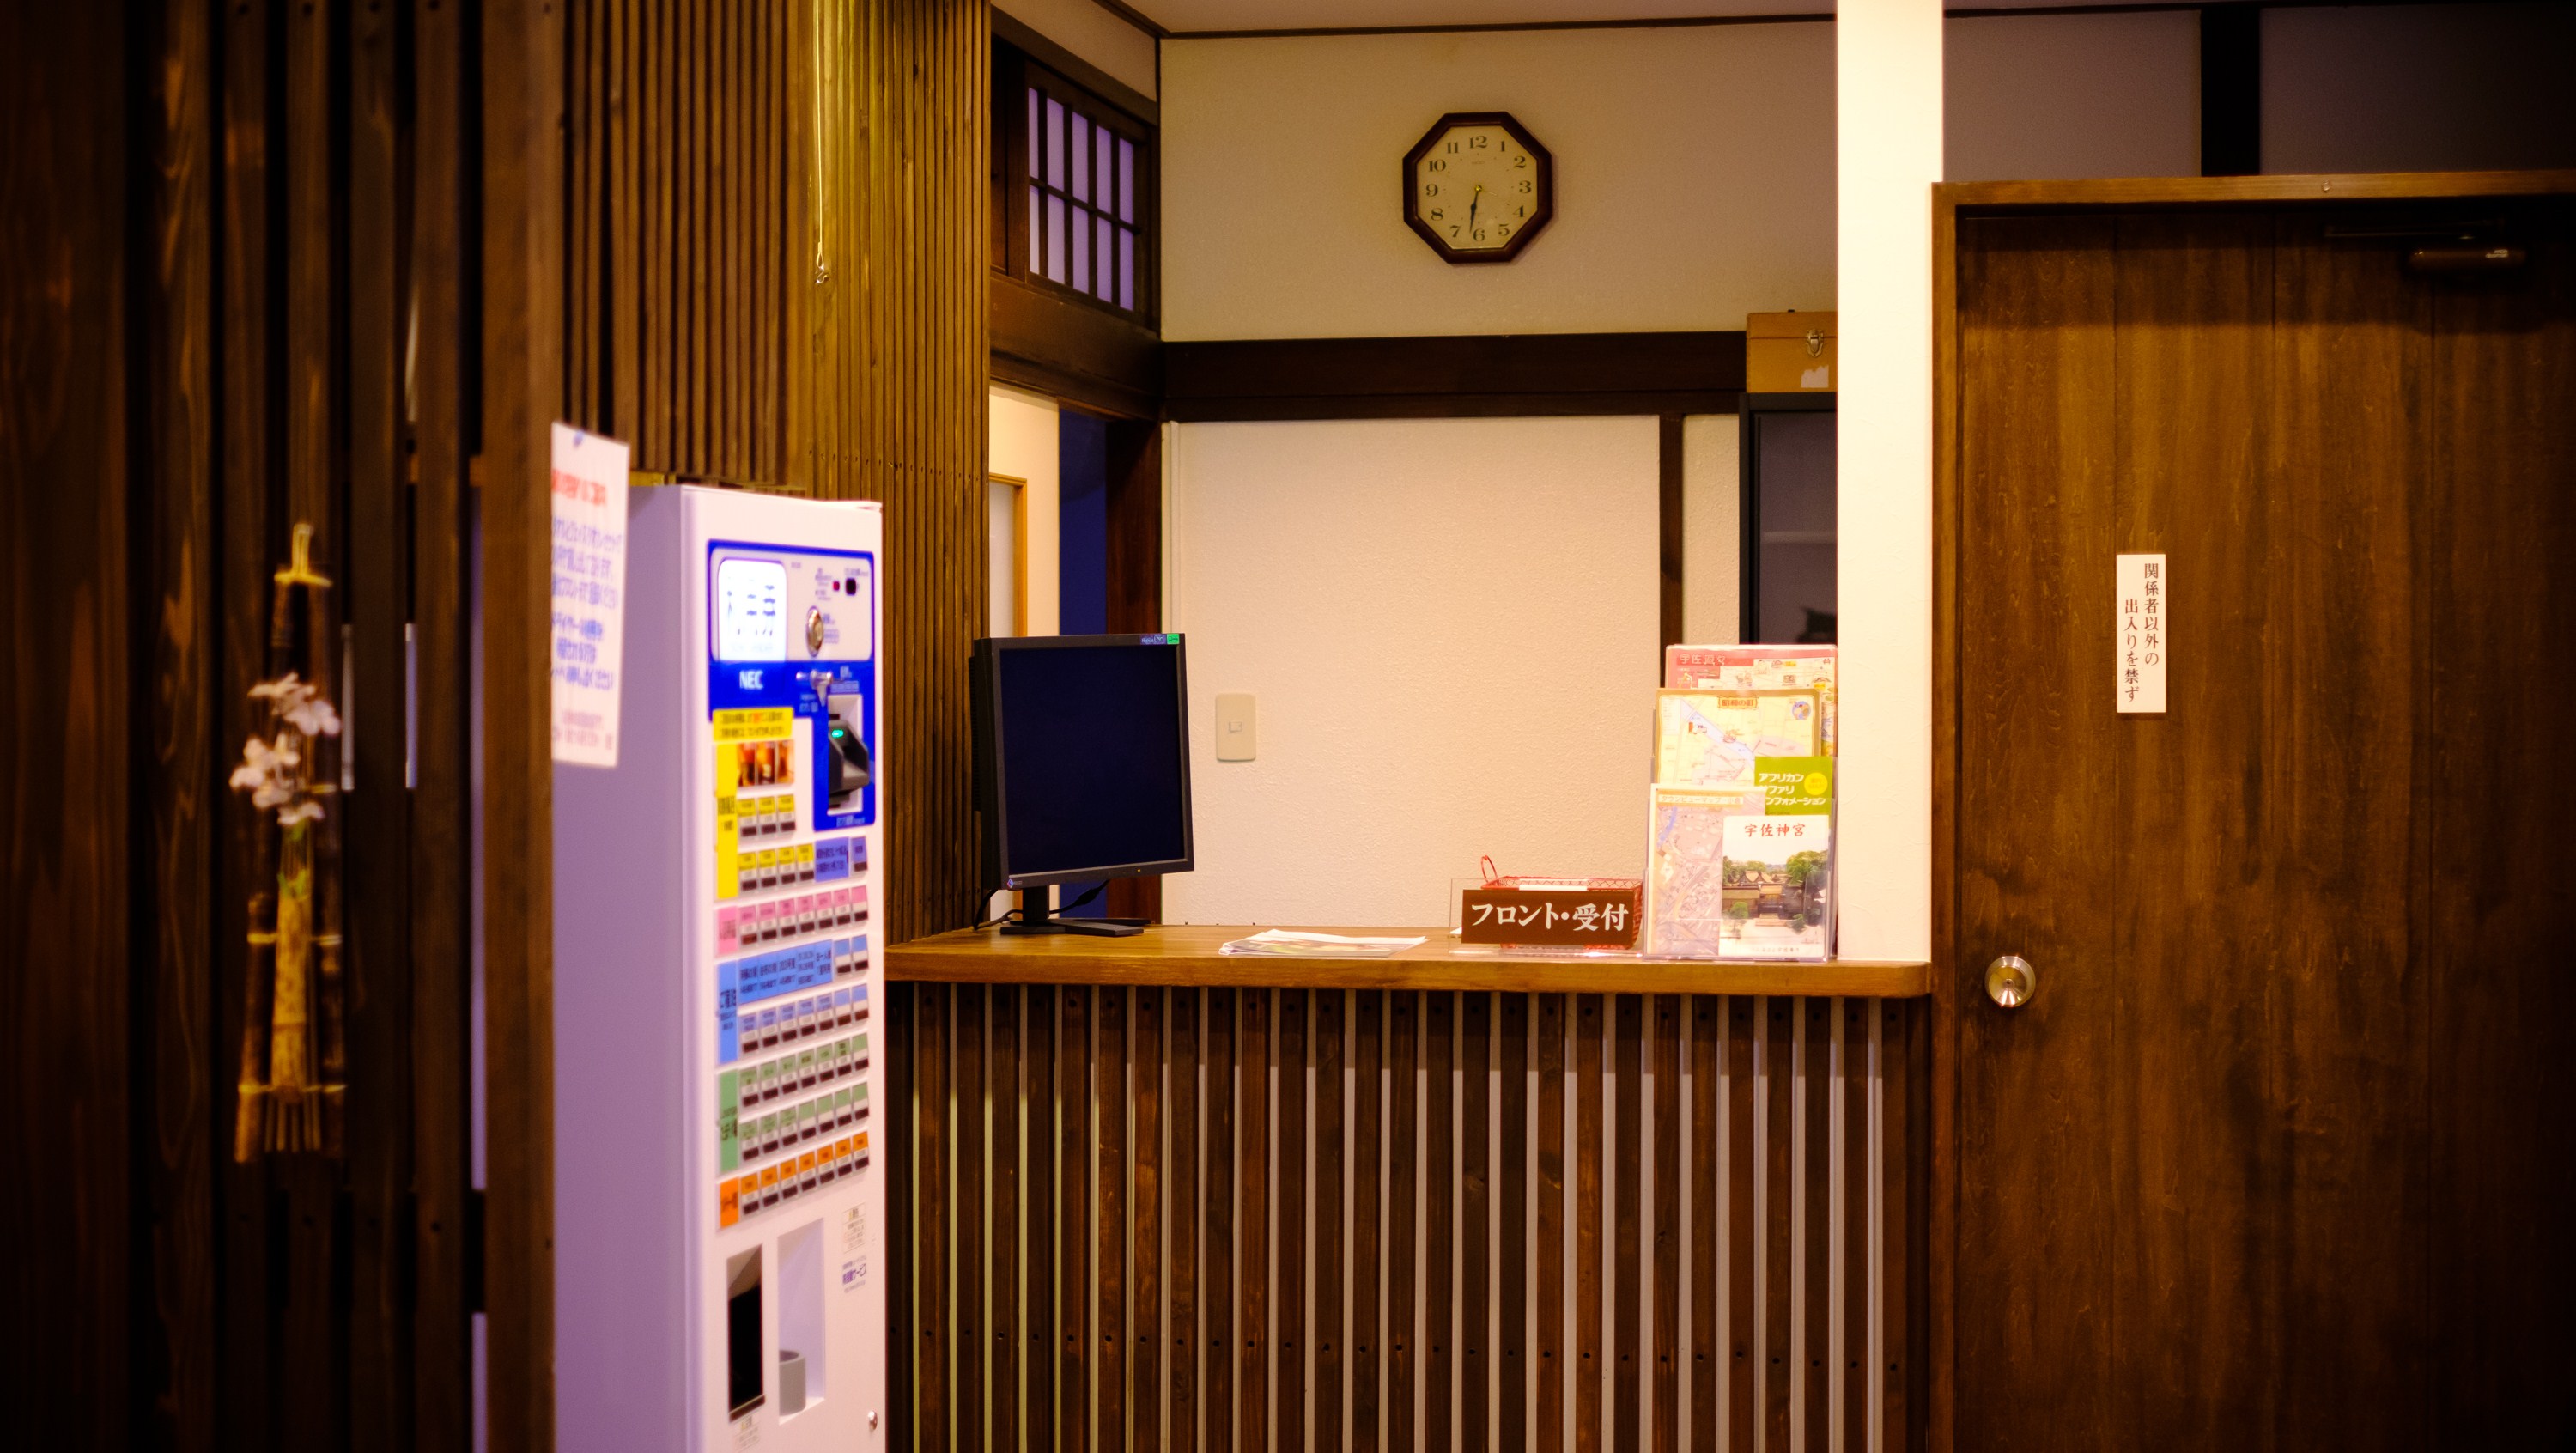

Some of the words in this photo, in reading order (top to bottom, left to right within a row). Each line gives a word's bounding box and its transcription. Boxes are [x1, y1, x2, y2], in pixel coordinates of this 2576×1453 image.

[1447, 142, 1459, 154] 11
[1469, 136, 1488, 149] 12
[1500, 140, 1506, 152] 1
[1428, 160, 1446, 172] 10
[1514, 155, 1526, 168] 2
[1426, 185, 1438, 197] 9
[1519, 180, 1531, 193] 3
[1431, 208, 1443, 221] 8
[1513, 205, 1524, 217] 4
[1450, 225, 1461, 238] 7
[1473, 228, 1485, 241] 6
[1498, 224, 1510, 236] 5
[2144, 563, 2159, 666] 関係者以外の
[2124, 599, 2139, 702] 出入りを禁ず
[739, 670, 763, 690] NEC
[1759, 773, 1805, 783] アフリカン
[1744, 823, 1806, 837] 宇佐神宮
[1471, 903, 1629, 932] フロント・受付
